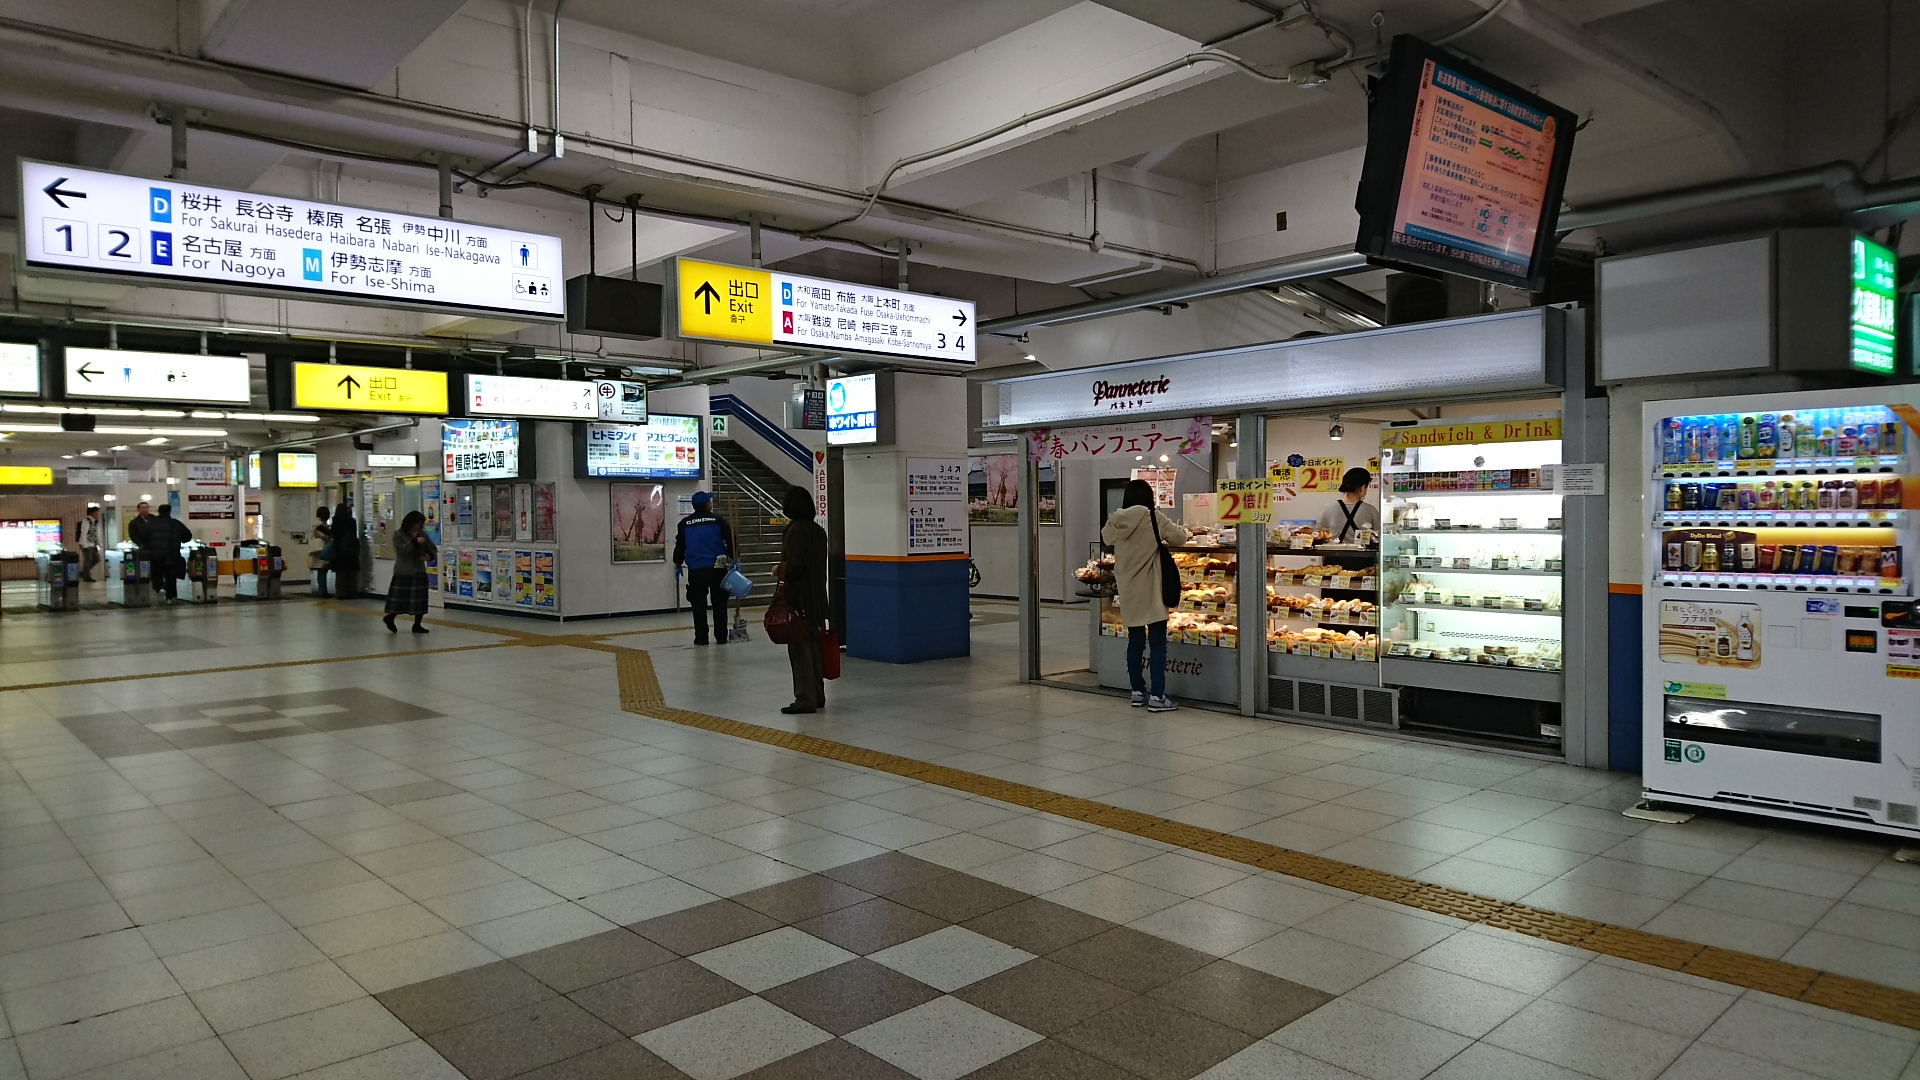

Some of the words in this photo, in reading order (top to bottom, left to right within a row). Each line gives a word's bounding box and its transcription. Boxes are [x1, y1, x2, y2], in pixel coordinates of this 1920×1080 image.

[153, 196, 168, 214] D
[181, 191, 222, 213] 桜井
[236, 198, 294, 223] 長谷寺
[307, 208, 344, 229] 榛原
[356, 215, 391, 236] 名張
[402, 222, 461, 245] 伊勢中川
[465, 235, 488, 249] 方面
[55, 224, 75, 253] 1
[107, 230, 133, 259] 2
[156, 239, 168, 257] E
[181, 213, 203, 227] For
[210, 216, 258, 234] Sakurai
[265, 223, 323, 242] Hasedera
[330, 231, 376, 249] Haibara
[382, 238, 420, 254] Nabari
[426, 243, 501, 265] Ise-Nakagawa
[182, 235, 243, 258] 名古屋
[250, 247, 277, 261] 方面
[182, 255, 210, 270] For
[221, 259, 286, 280] Nagoya
[305, 256, 320, 273] M
[331, 251, 403, 275] 伊勢志摩
[409, 266, 432, 279] 方面
[331, 271, 356, 285] For
[366, 274, 435, 294] Ise-Shima
[729, 279, 758, 299] 出口
[783, 287, 791, 300] D
[797, 285, 831, 301] 大和高田
[836, 290, 856, 304] 布施
[861, 294, 900, 311] 大阪上本町
[903, 303, 916, 312] 方面
[729, 298, 754, 314] Exit
[797, 298, 807, 308] For
[811, 301, 858, 315] Yamato-Takada
[860, 306, 874, 317] Fuse
[784, 317, 793, 329] A
[797, 313, 832, 329] 大阪難波
[837, 317, 857, 331] 尼崎
[862, 320, 898, 336] 神戸三宮
[901, 329, 913, 338] 方面
[797, 327, 807, 336] For
[937, 333, 946, 349] 3
[955, 335, 966, 352] 4
[369, 375, 397, 390] 出口
[1092, 374, 1170, 406] Panneterie
[369, 391, 391, 402] Exit
[571, 401, 578, 411] 3
[584, 402, 591, 411] 4
[1402, 426, 1474, 444] Sandwich
[1484, 425, 1493, 439] &
[1504, 422, 1553, 438] Drink
[1050, 431, 1184, 459] 春パンフェアー
[940, 465, 945, 473] 3
[947, 465, 952, 473] 4
[1272, 468, 1291, 477] 復活
[819, 469, 827, 490] AED
[1220, 481, 1271, 491] 本日ポイント
[927, 507, 933, 516] 2
[1252, 511, 1271, 523] Day
[1690, 532, 1704, 541] DyDo
[1706, 532, 1722, 540] Blend
[1681, 614, 1717, 624] ラテ時間
